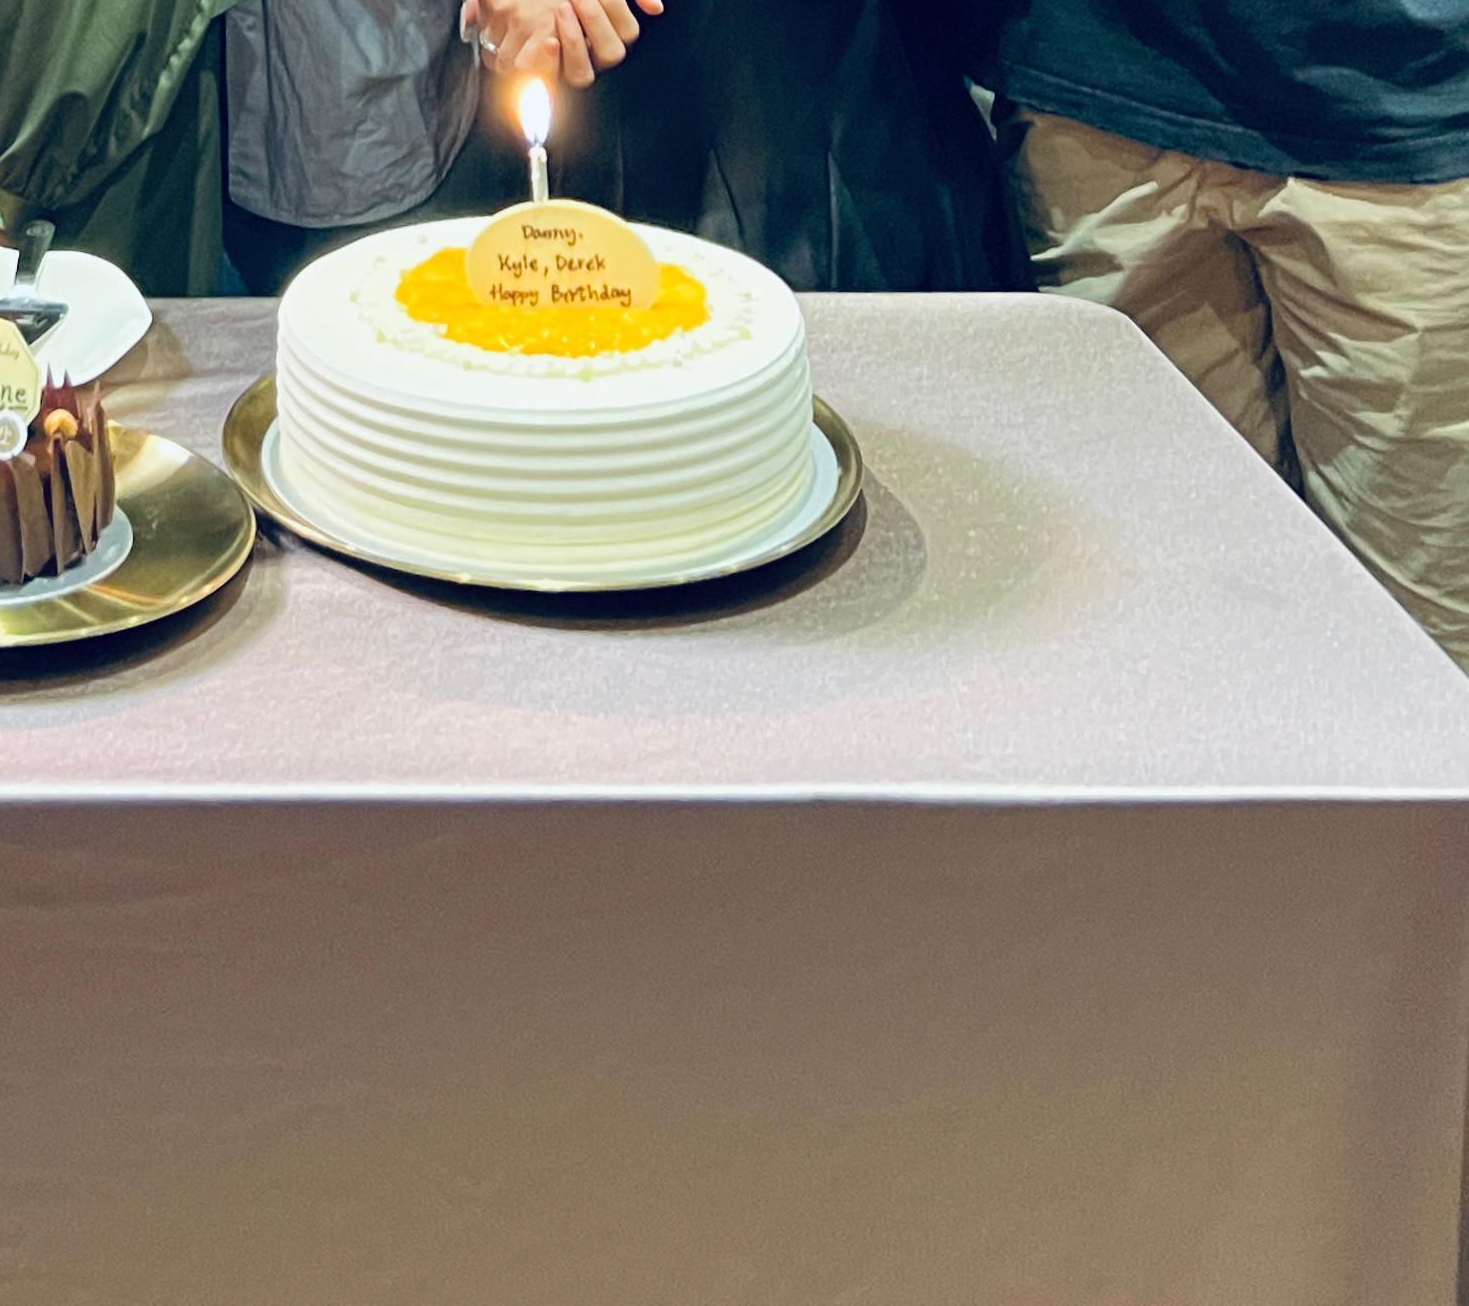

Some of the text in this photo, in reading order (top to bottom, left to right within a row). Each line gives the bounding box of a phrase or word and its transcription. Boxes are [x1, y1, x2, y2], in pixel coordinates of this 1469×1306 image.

[497, 254, 606, 278] Kyle, Derek
[489, 283, 631, 308] Happy Birthday
